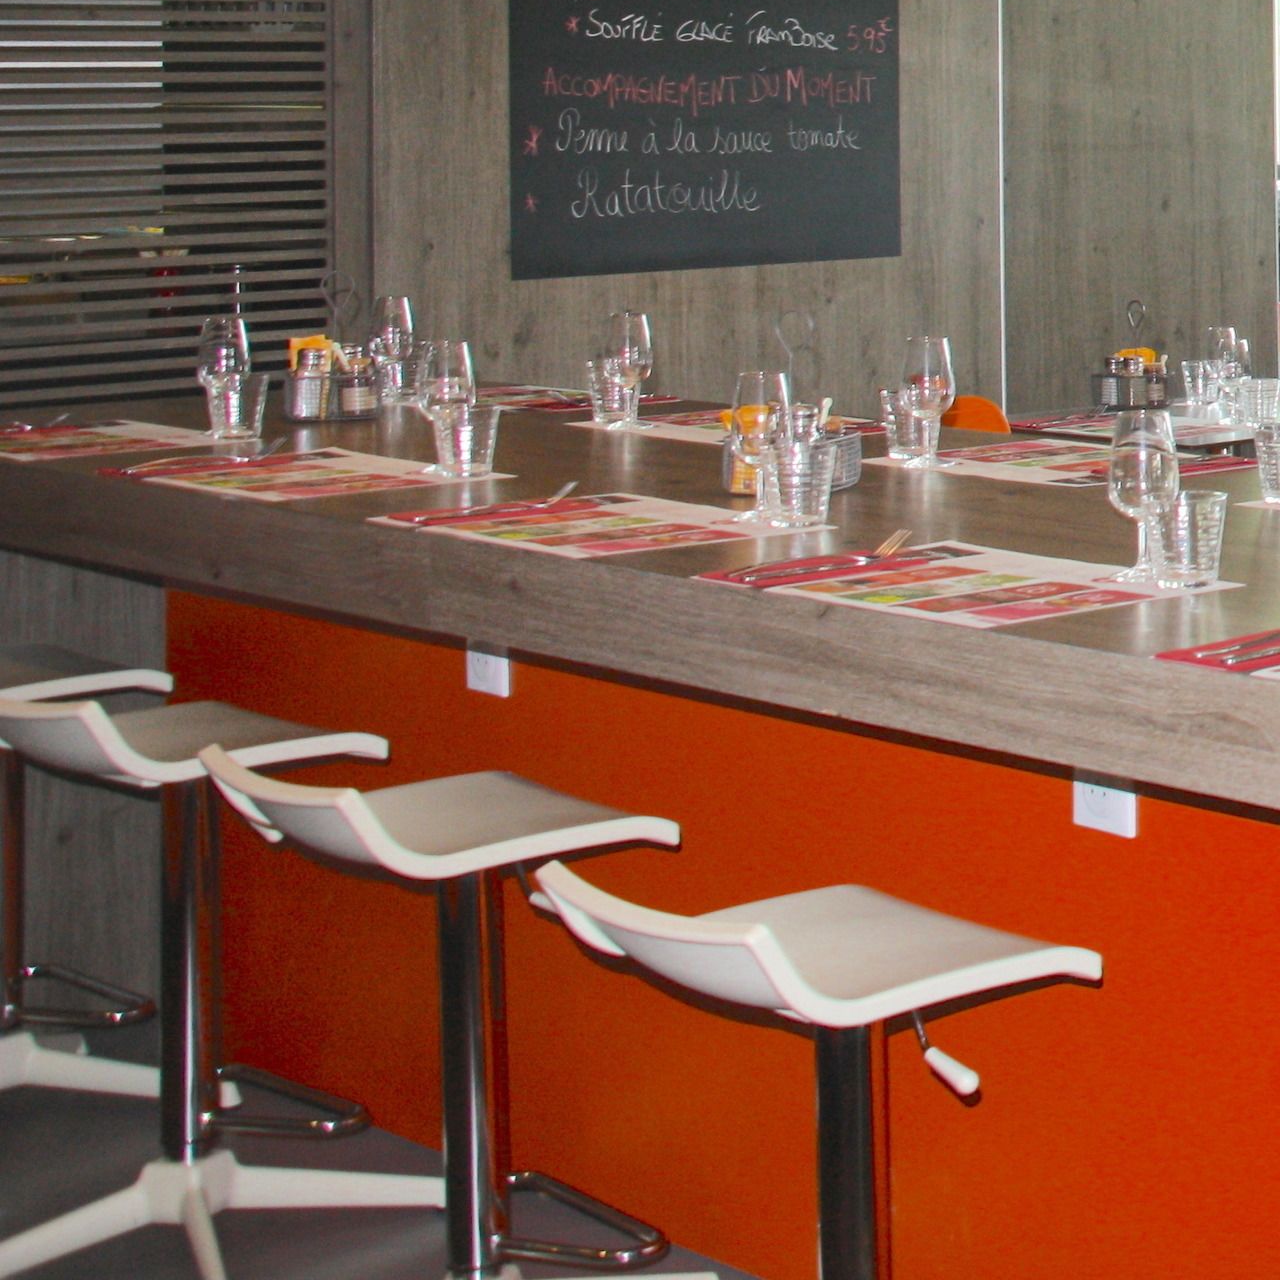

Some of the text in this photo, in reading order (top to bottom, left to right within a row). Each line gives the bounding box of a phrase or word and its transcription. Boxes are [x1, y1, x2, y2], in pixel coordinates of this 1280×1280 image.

[555, 107, 630, 153] Penne
[665, 116, 701, 155] la
[706, 126, 774, 155] sauce
[786, 114, 864, 152] tomate
[570, 167, 762, 219] Ratatouille
